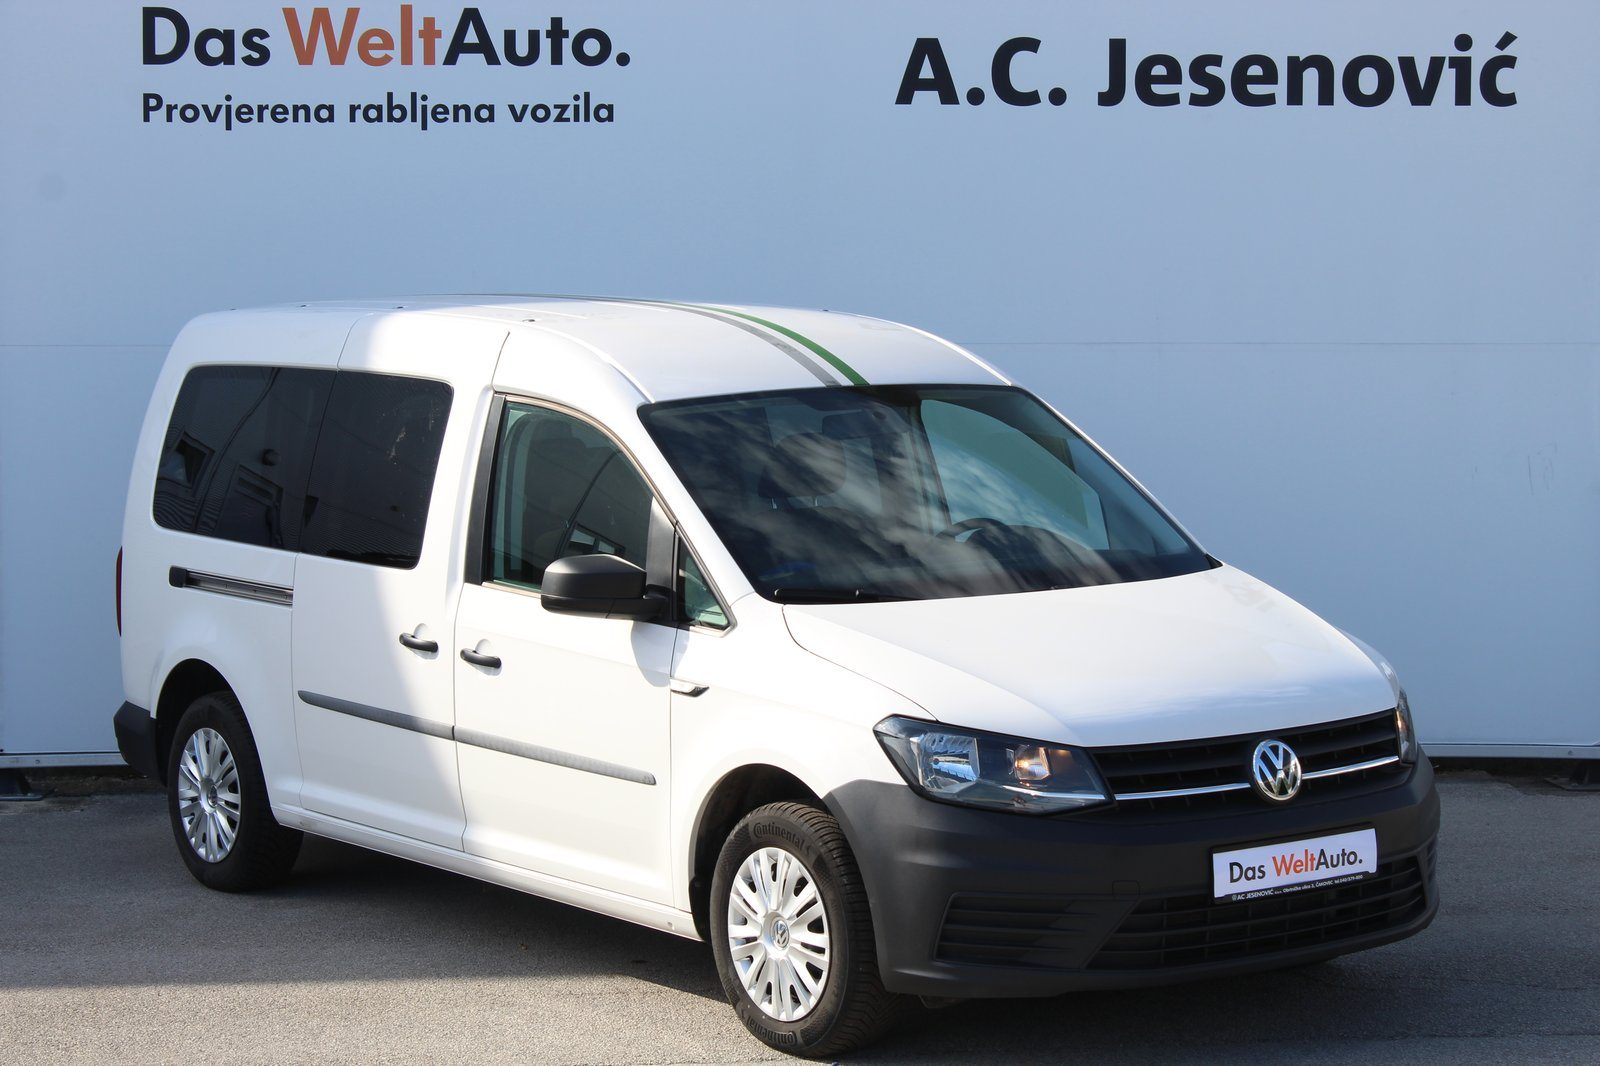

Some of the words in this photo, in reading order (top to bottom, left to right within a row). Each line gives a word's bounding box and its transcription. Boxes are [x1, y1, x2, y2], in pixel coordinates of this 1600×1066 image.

[143, 7, 271, 67] Das
[283, 5, 630, 67] WeltAuto.
[895, 37, 1068, 107] A.C.
[1098, 31, 1518, 108] Jesenović
[143, 92, 335, 132] Provjerena
[350, 91, 495, 131] rabljena
[508, 92, 614, 124] vozila
[753, 822, 805, 850] Continental
[1229, 862, 1266, 884] Das
[1272, 849, 1363, 877] WeltAuto.
